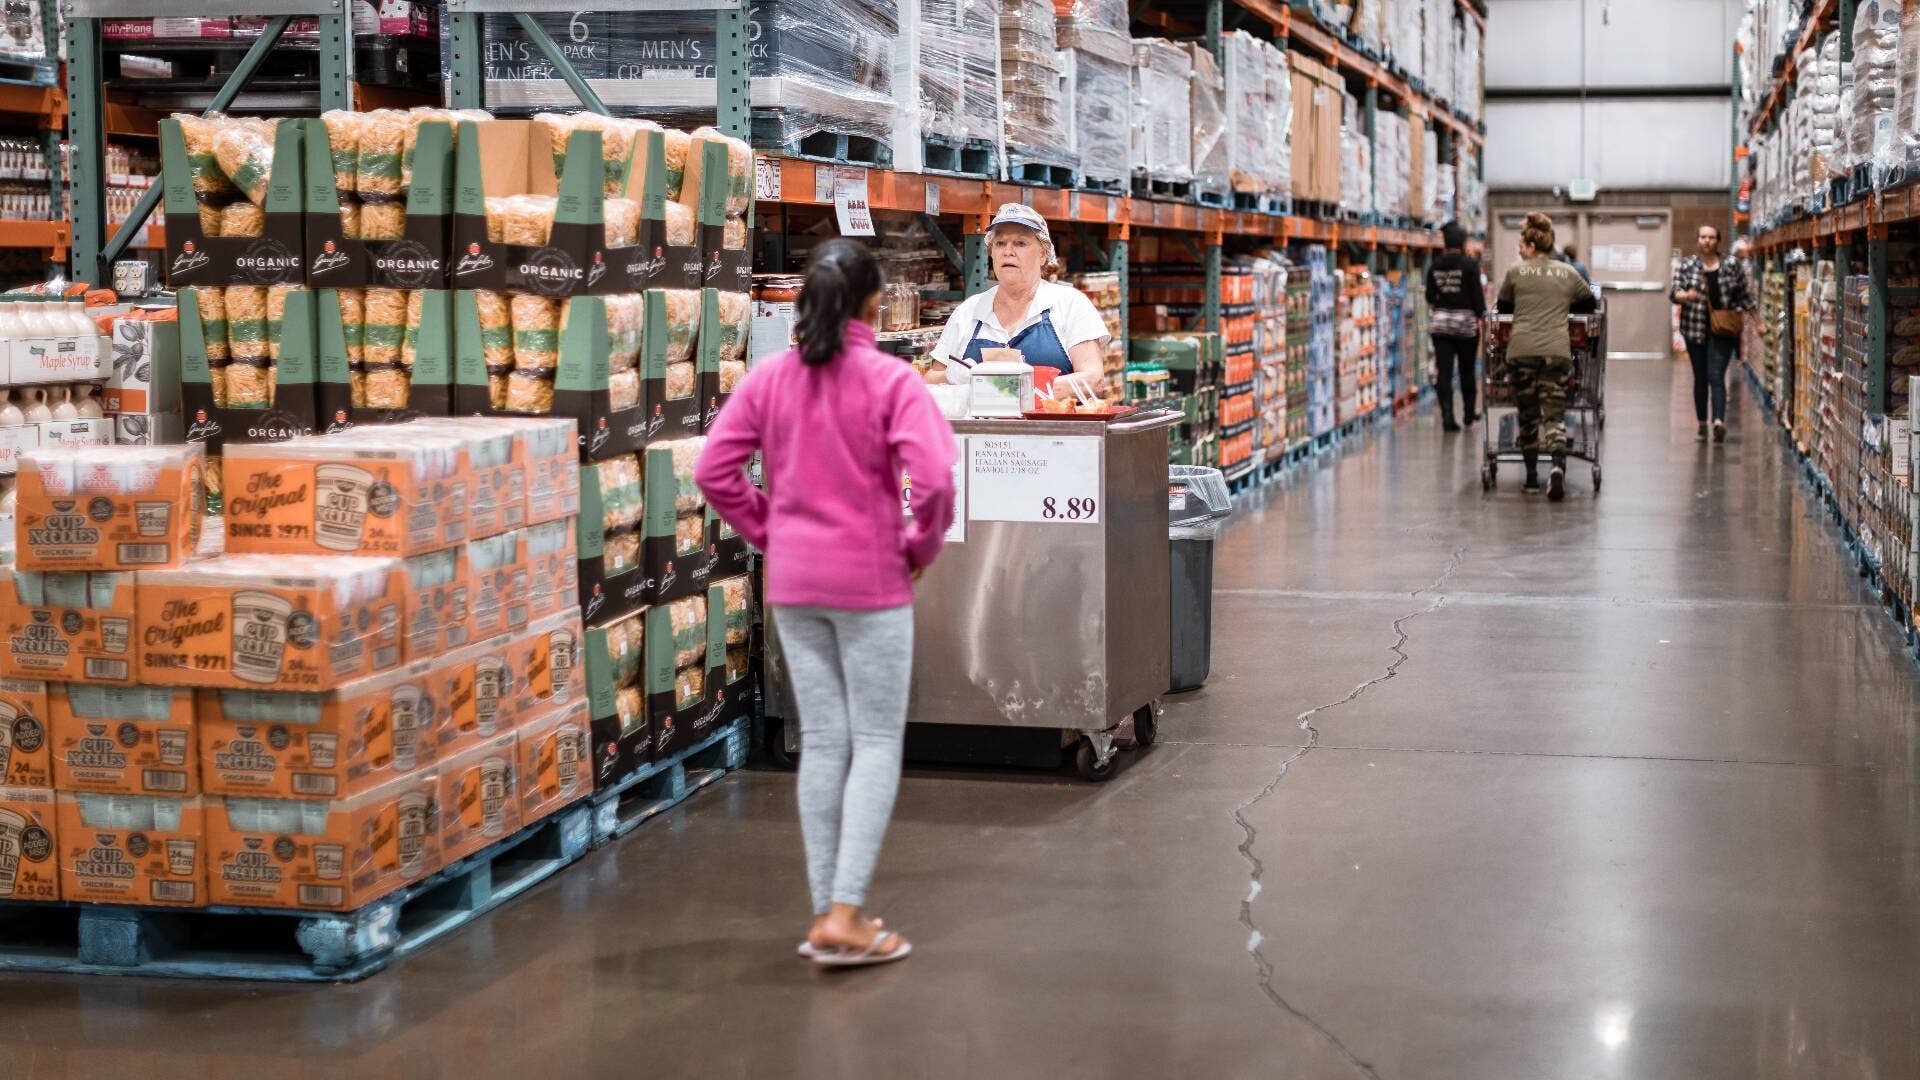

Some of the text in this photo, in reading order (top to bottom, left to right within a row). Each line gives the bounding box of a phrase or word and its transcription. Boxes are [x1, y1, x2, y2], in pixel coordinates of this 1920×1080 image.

[569, 11, 590, 42] 6
[564, 45, 597, 58] PACK
[642, 39, 701, 59] MEN'S
[236, 257, 300, 267] ORGANIC
[376, 259, 440, 270] ORGANIC
[520, 264, 583, 279] ORGANIC
[41, 354, 91, 371] Maple Syrup
[248, 428, 313, 437] ORGANIC
[246, 472, 282, 493] The
[230, 484, 306, 518] Original
[327, 493, 361, 511] CUP
[1042, 496, 1096, 519] 8.89
[46, 515, 84, 530] CUP
[230, 523, 309, 538] SINCE 1971
[28, 528, 99, 545] NOODLES
[161, 601, 198, 621] The
[26, 624, 58, 640] CUP
[144, 612, 224, 648] Original
[243, 623, 279, 640] CUP
[11, 637, 69, 656] NOODLES
[144, 653, 226, 669] SINCE 1971
[80, 738, 115, 753] CUP
[230, 741, 264, 756] CUP
[15, 762, 30, 773] 24
[67, 751, 126, 769] NOODLES
[215, 753, 276, 771] NOODLES
[8, 776, 46, 785] 2.5 OZ
[89, 849, 123, 863] CUP
[236, 852, 270, 866] CUP
[23, 872, 38, 882] 24
[75, 861, 135, 879] NOODLES
[222, 864, 281, 883] NOODLES
[17, 885, 54, 896] 2.5 OZ
